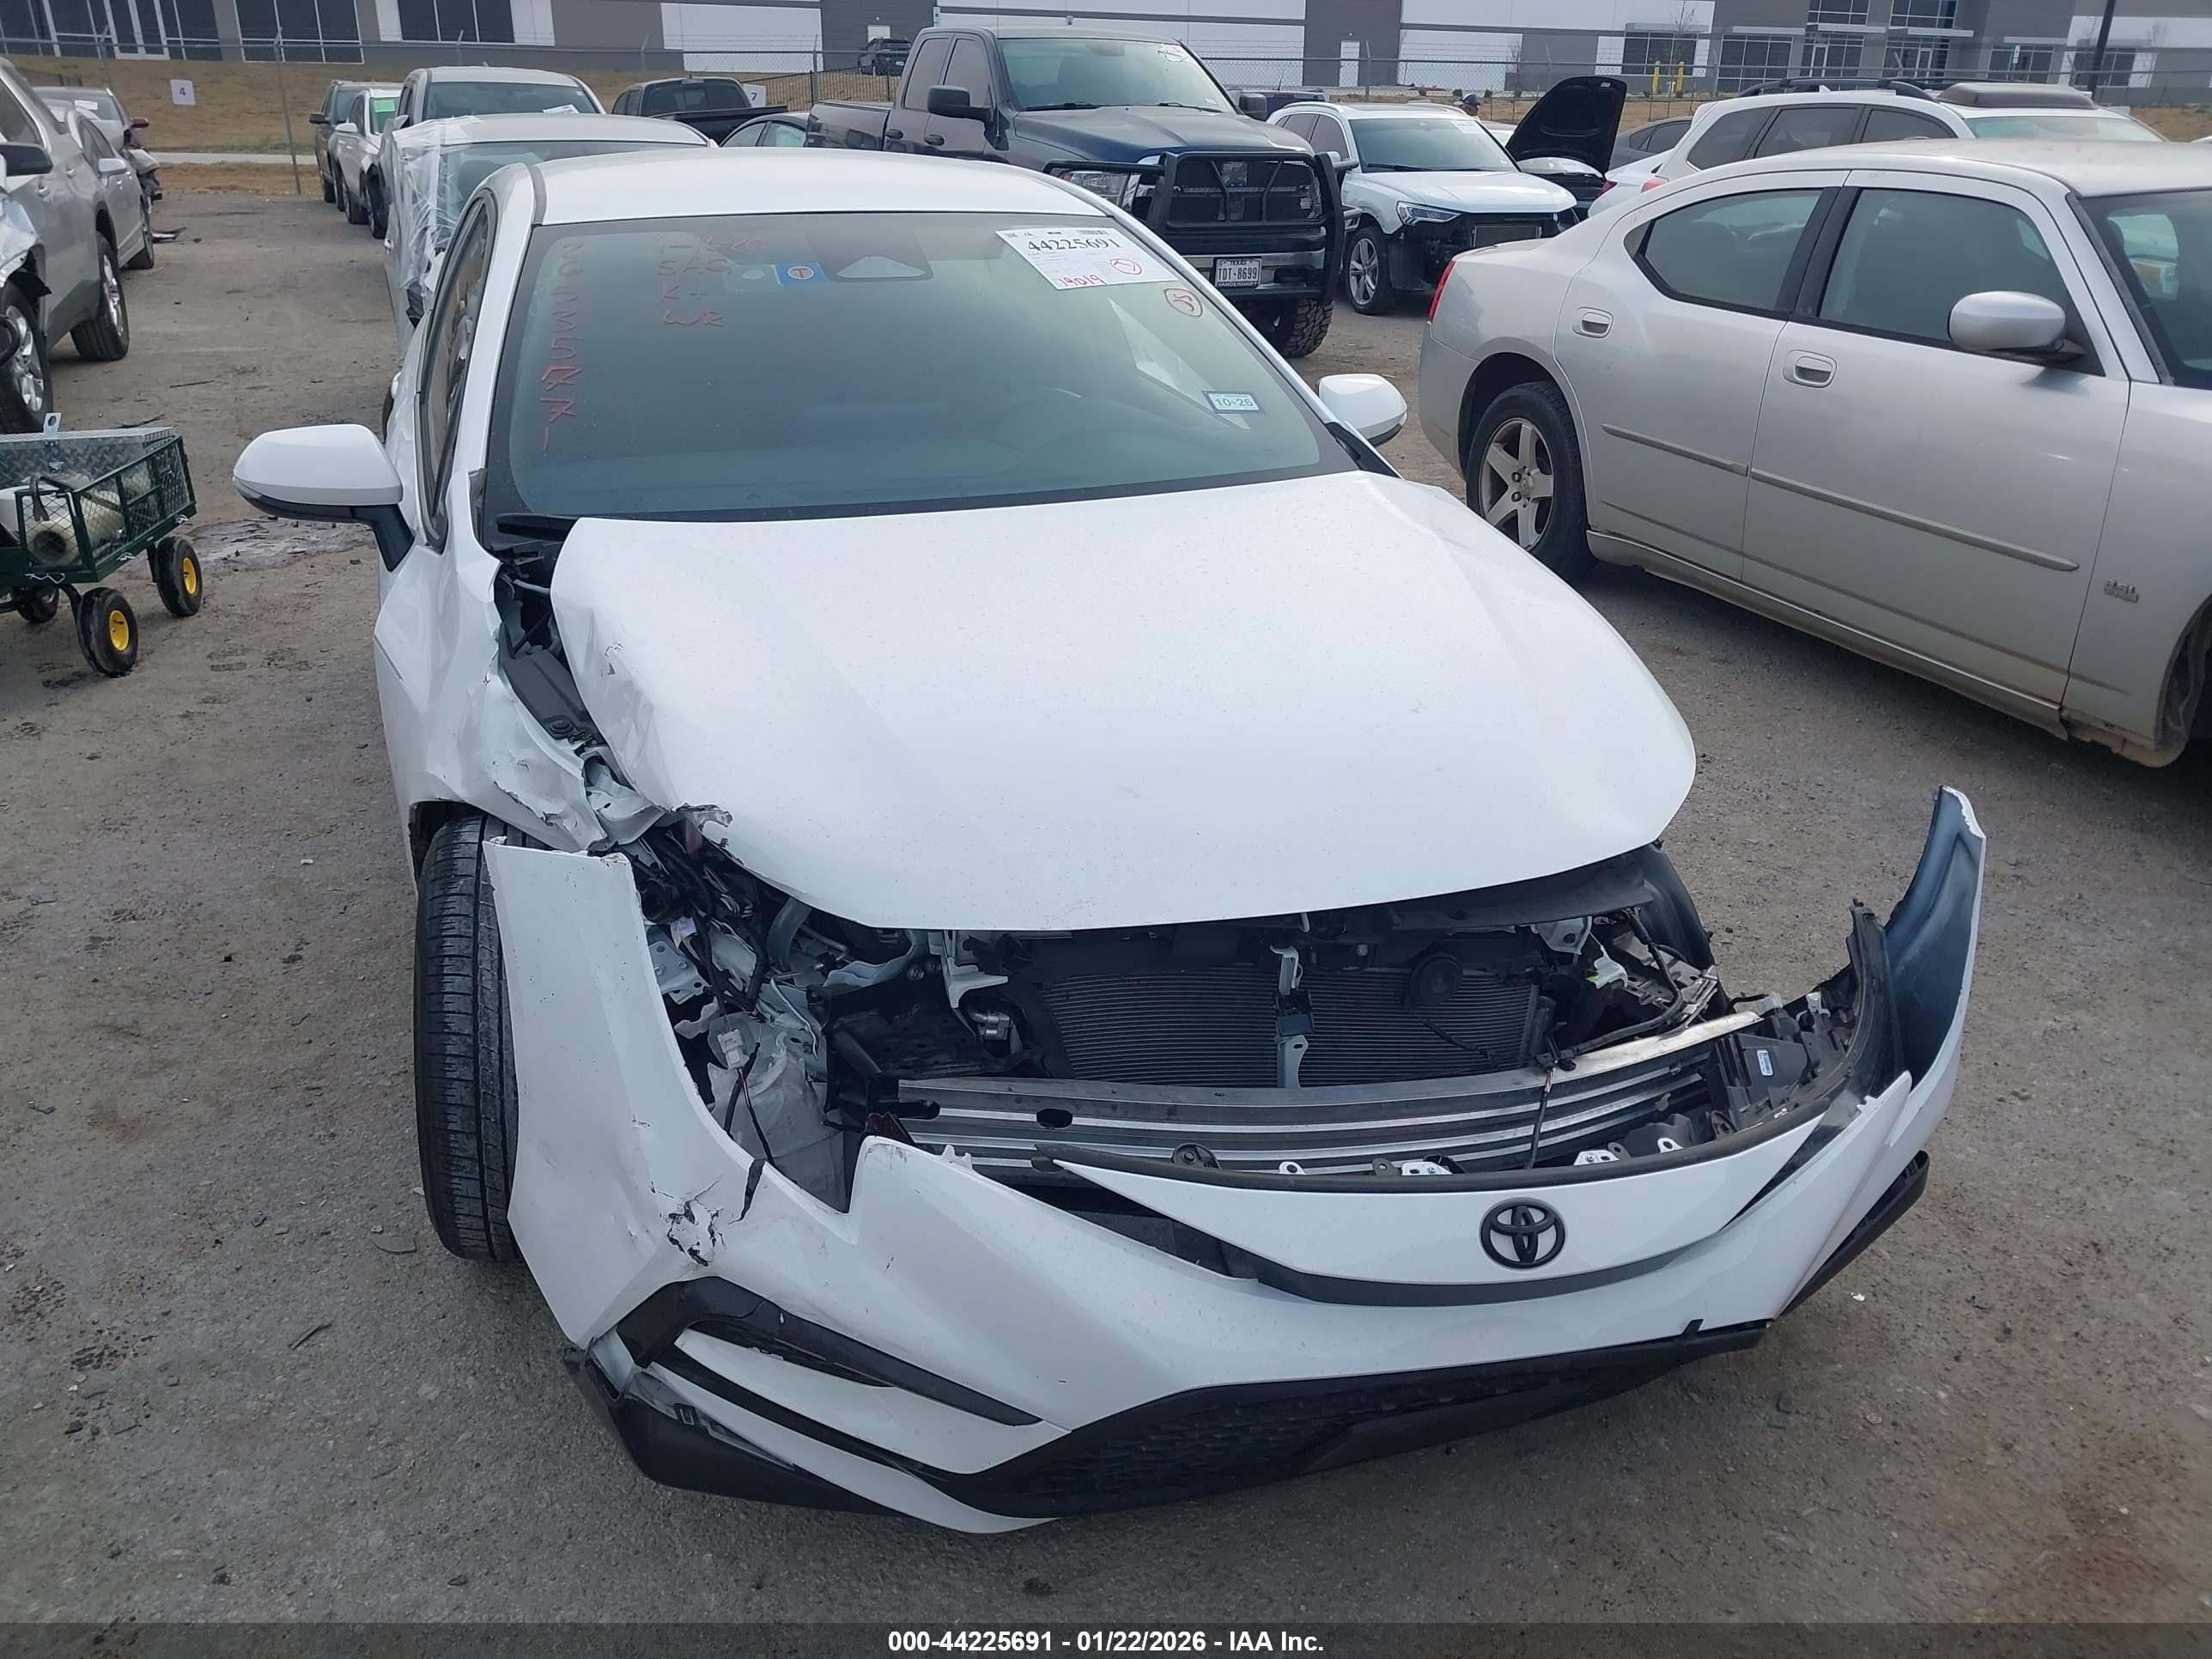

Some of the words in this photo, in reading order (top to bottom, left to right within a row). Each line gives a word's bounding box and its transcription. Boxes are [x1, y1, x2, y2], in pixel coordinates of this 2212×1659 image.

[179, 88, 185, 96] 4
[751, 92, 757, 101] 7
[1028, 239, 1121, 252] 44225691
